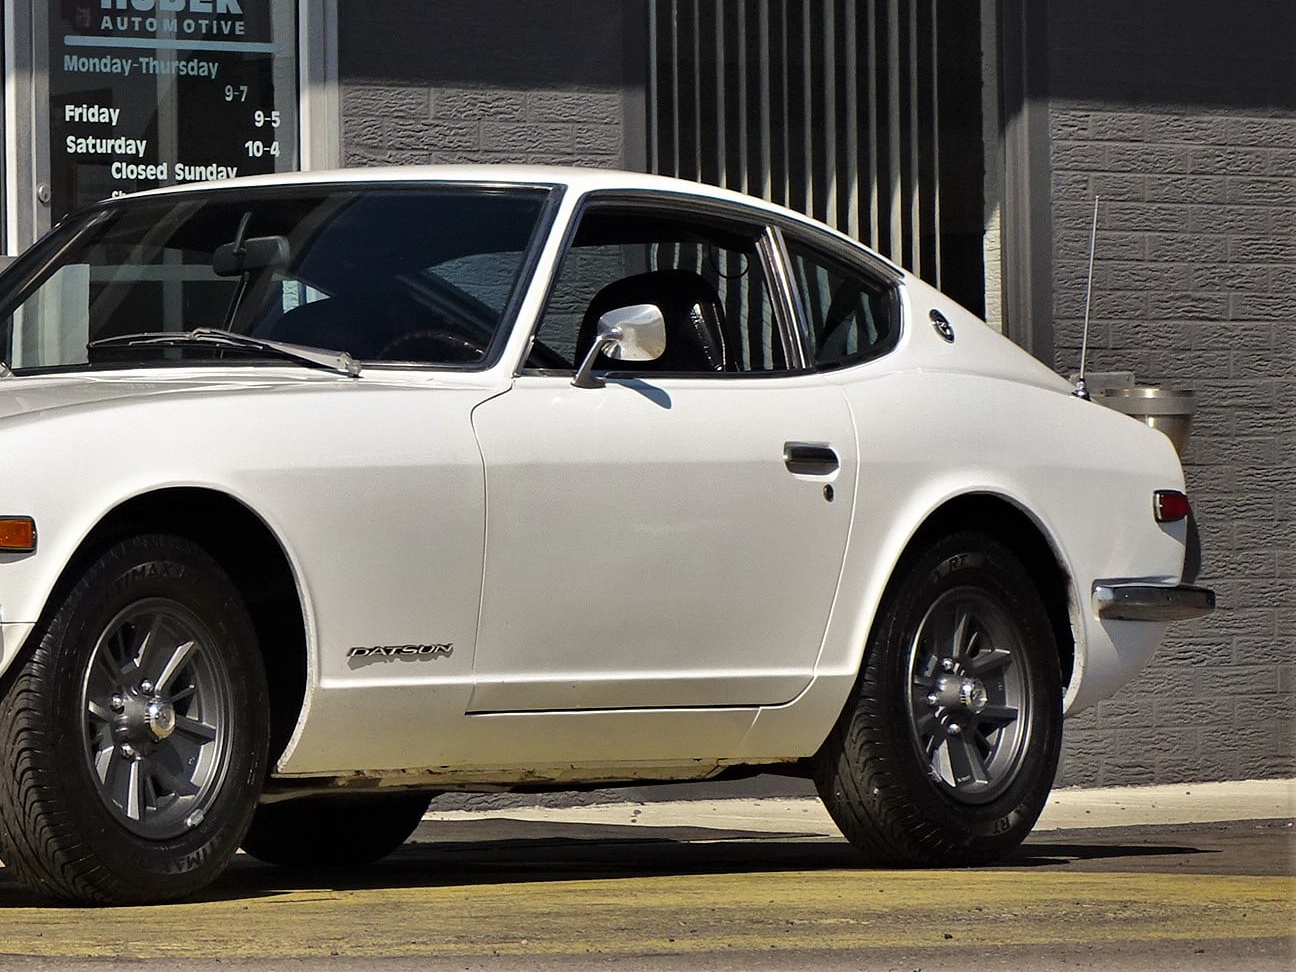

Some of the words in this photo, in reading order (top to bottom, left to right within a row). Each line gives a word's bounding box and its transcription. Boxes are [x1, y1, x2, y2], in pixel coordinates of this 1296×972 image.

[100, 16, 245, 36] AUTOMOTIVE
[224, 84, 248, 103] 9-7
[64, 104, 120, 126] Friday
[254, 110, 281, 128] 9-5
[65, 135, 147, 158] Saturday
[244, 140, 281, 158] 10-4
[111, 161, 168, 180] Closed
[345, 641, 454, 658] DATSUN
